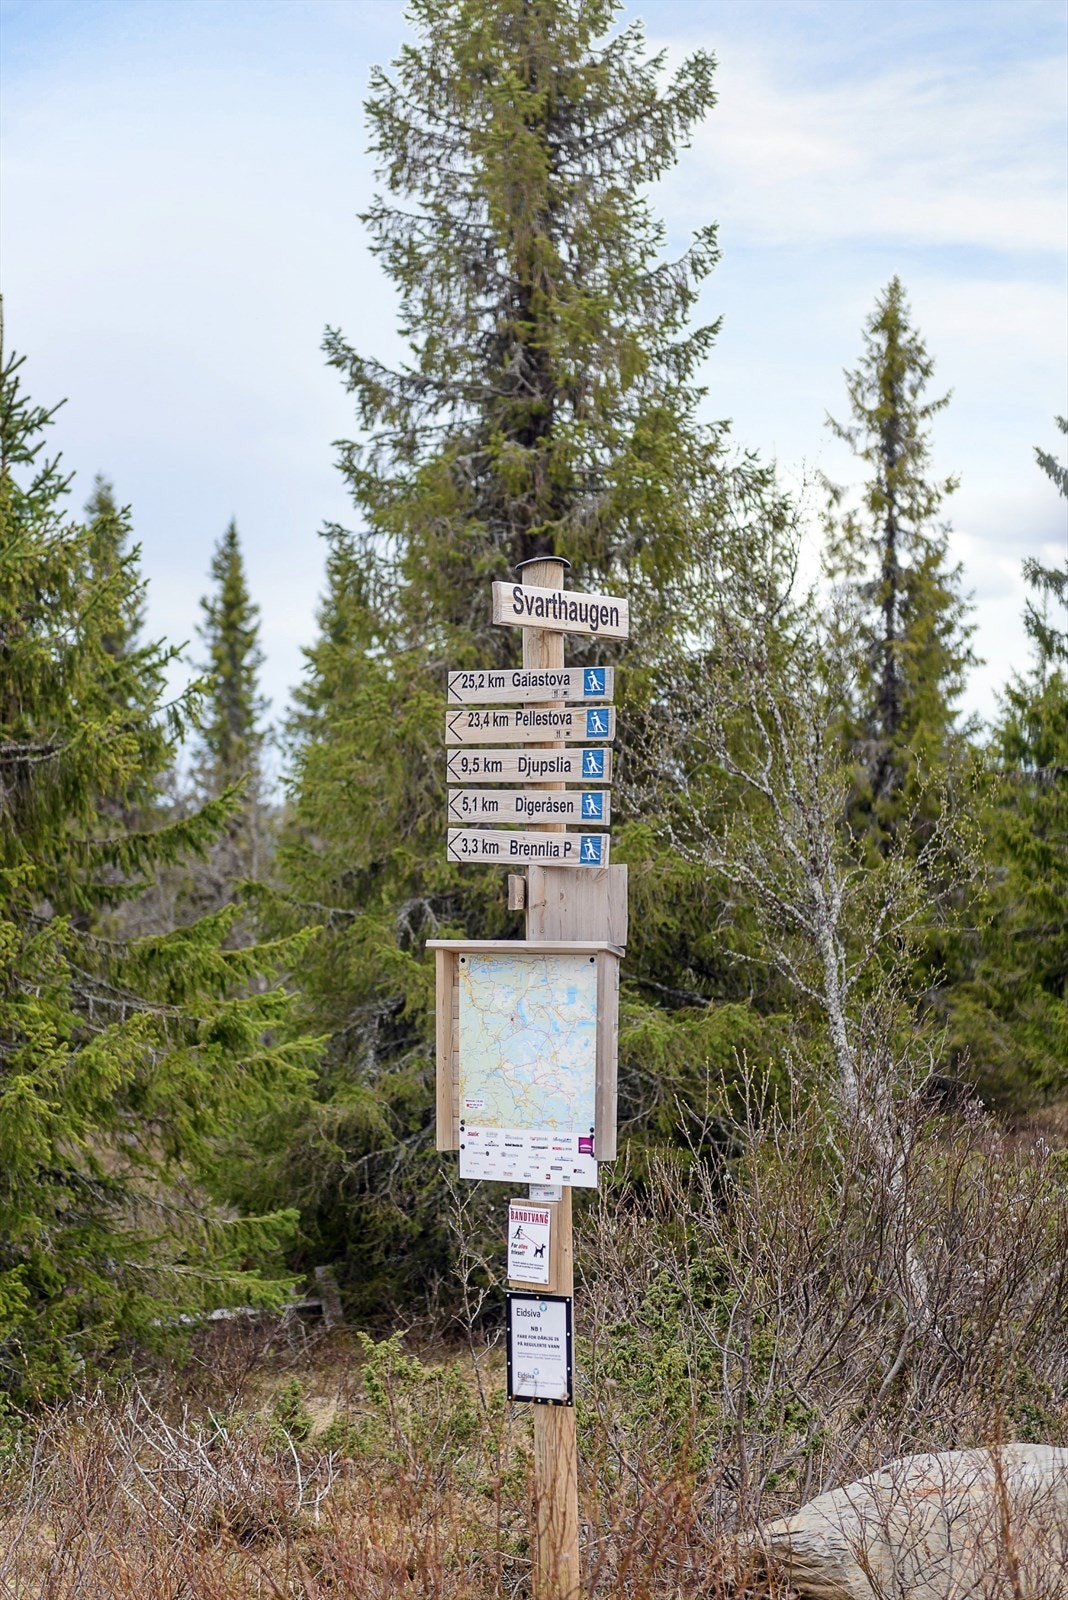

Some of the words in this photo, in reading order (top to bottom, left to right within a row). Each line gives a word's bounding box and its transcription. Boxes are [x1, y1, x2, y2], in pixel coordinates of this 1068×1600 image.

[512, 586, 619, 631] Svarthaugen
[462, 674, 485, 690] 25,2
[488, 674, 505, 688] km
[468, 712, 490, 729] 23,4
[493, 711, 509, 726] km
[515, 710, 572, 726] Pellestova
[461, 757, 480, 775] 9,5
[483, 758, 502, 772] km
[518, 757, 571, 777] Djupslia
[462, 797, 477, 814] 5,1
[481, 797, 499, 811] km
[515, 797, 574, 815] Digeråsen
[461, 838, 478, 856] 3,3
[482, 839, 499, 854] km
[510, 840, 559, 857] Brennlia
[564, 842, 572, 857] P
[516, 1308, 541, 1318] Eidsiva
